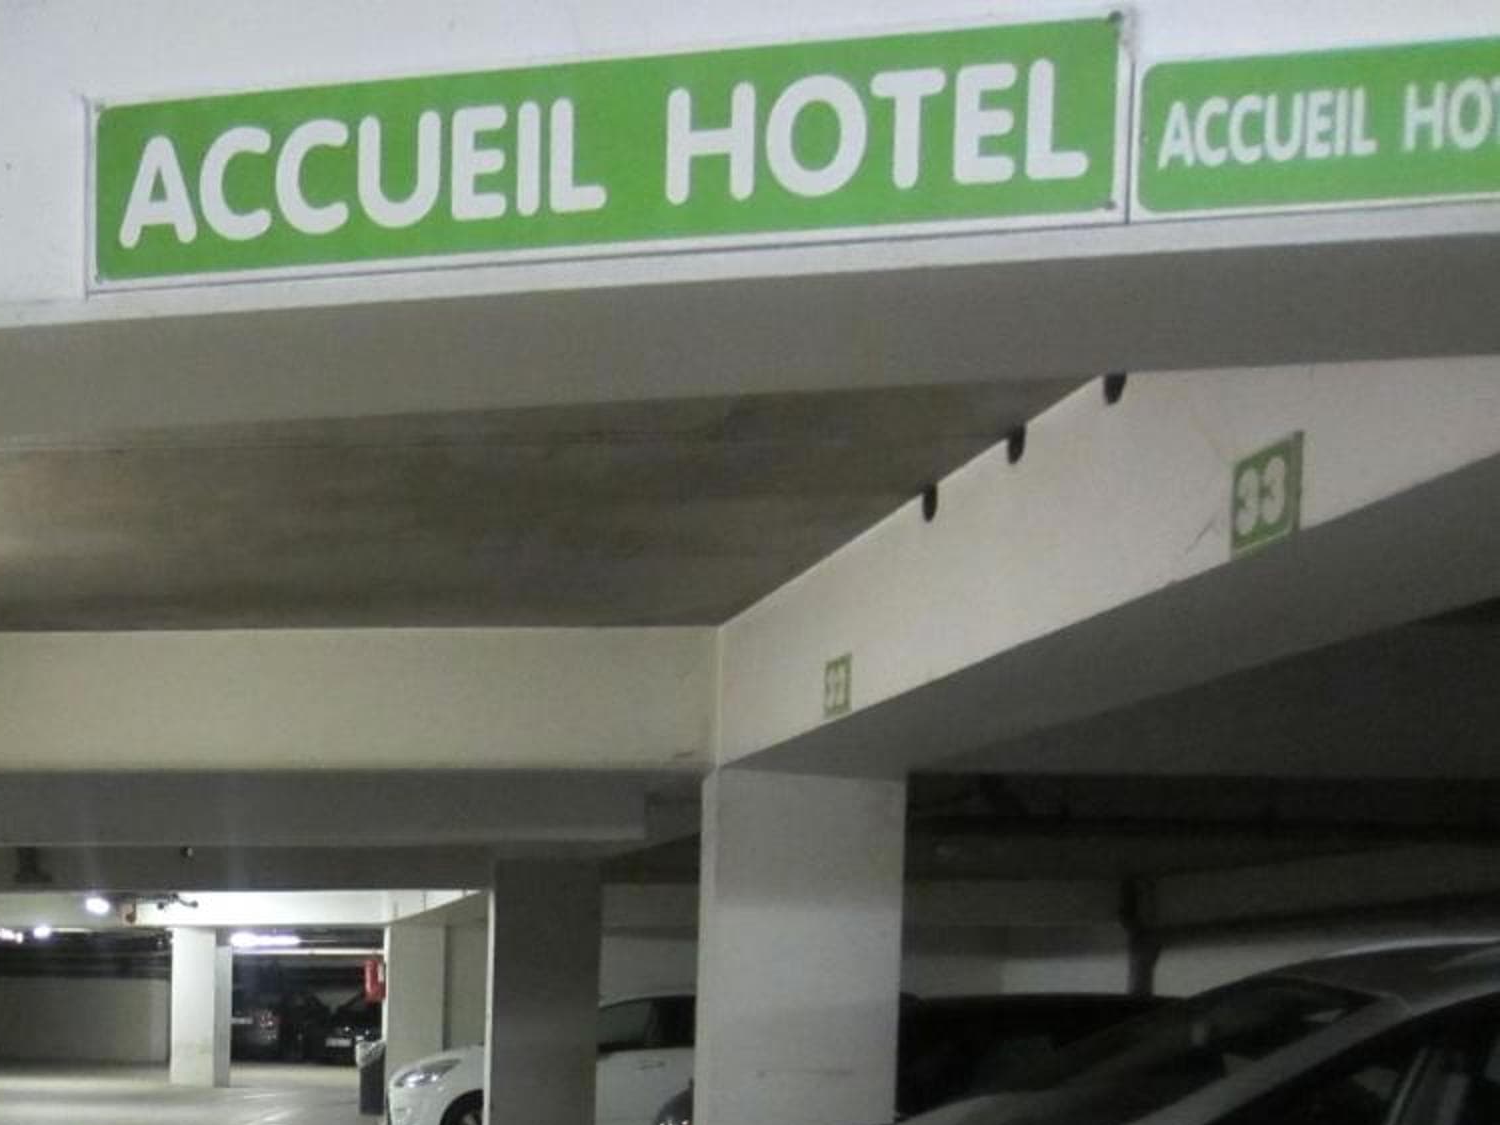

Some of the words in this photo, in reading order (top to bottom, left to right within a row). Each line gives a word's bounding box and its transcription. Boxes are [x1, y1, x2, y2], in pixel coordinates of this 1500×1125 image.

[118, 98, 609, 249] ACCUEIL
[664, 57, 1090, 205] HOTEL
[1156, 86, 1379, 171] ACCUEIL
[1403, 75, 1500, 153] HO
[1235, 456, 1285, 536] 33
